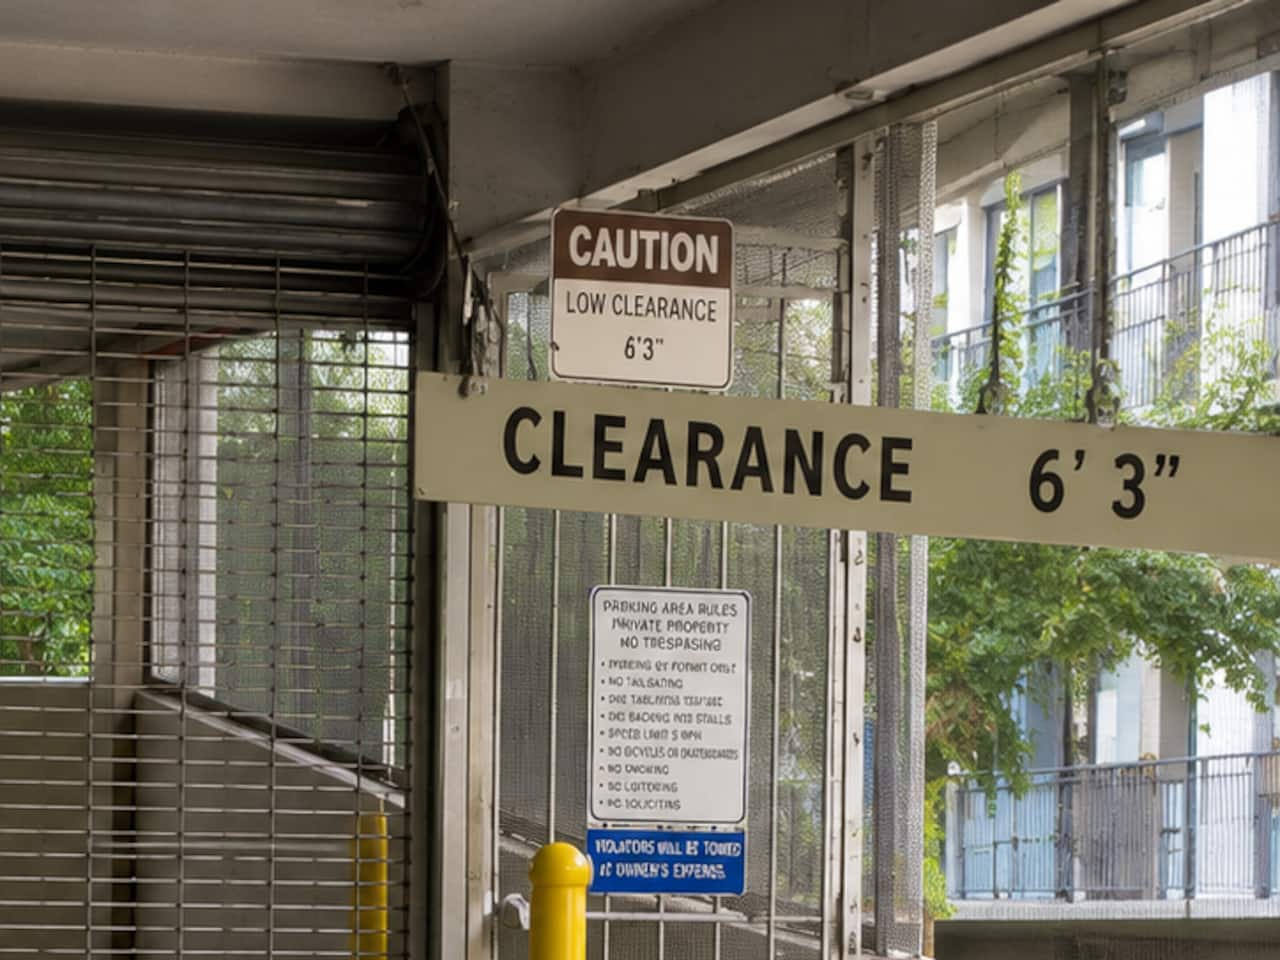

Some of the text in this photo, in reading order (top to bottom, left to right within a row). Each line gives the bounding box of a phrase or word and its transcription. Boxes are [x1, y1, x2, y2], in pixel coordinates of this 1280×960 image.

[569, 225, 719, 274] CAUTION
[566, 291, 717, 322] LOW CLEARANCE
[624, 335, 664, 360] 6'3"
[502, 405, 914, 504] CLEARANCE
[620, 636, 639, 650] NO
